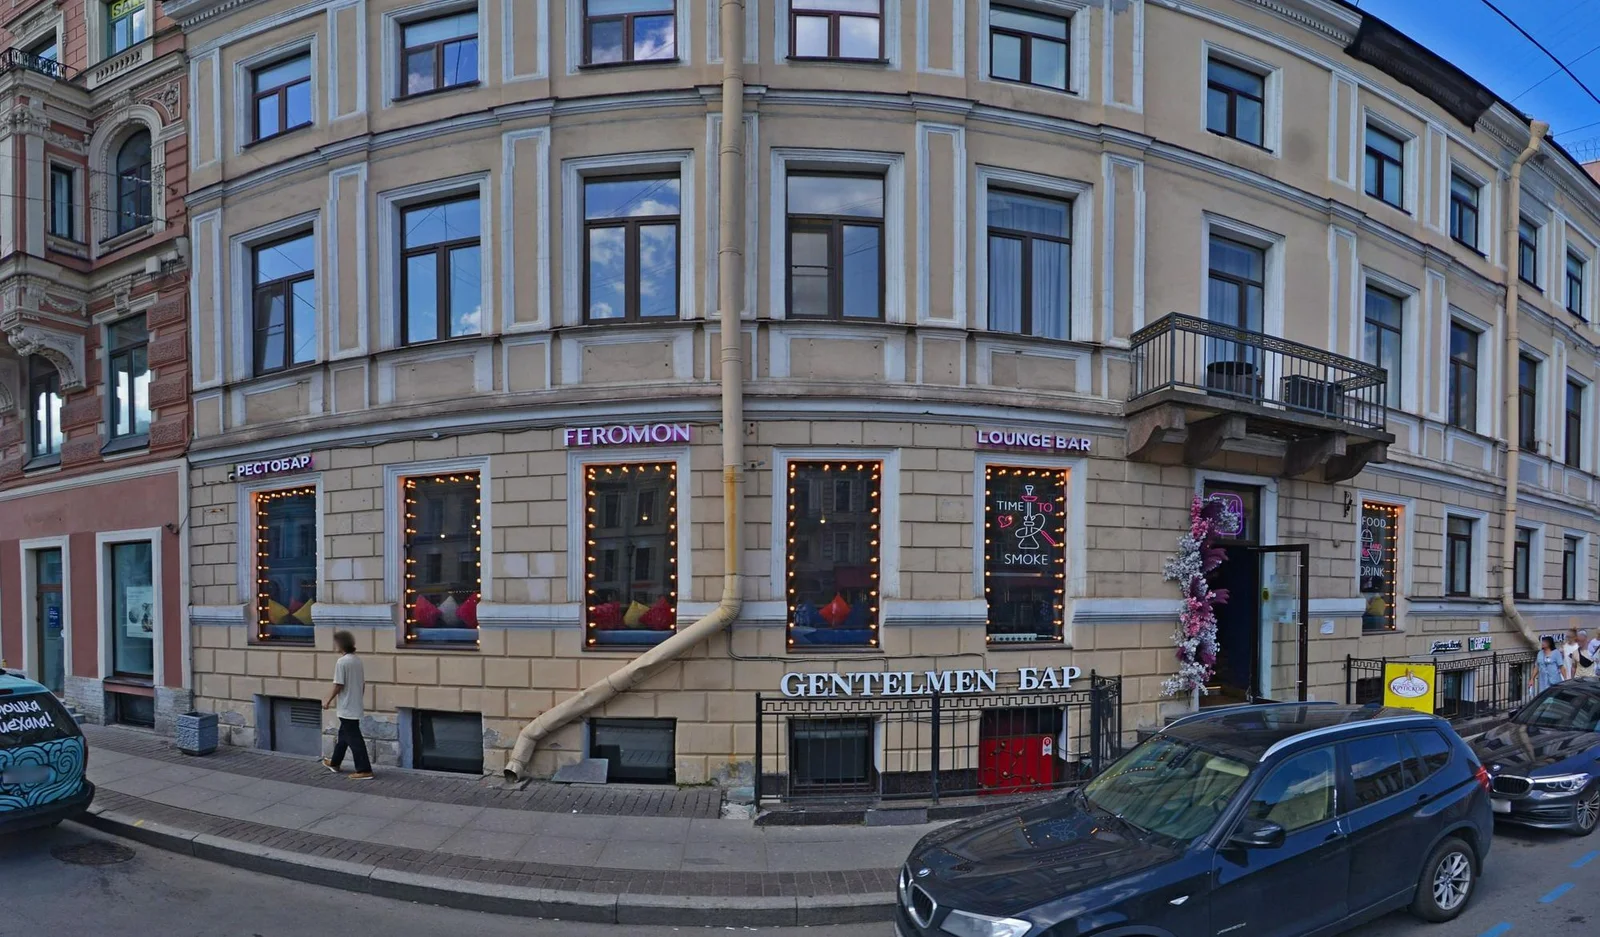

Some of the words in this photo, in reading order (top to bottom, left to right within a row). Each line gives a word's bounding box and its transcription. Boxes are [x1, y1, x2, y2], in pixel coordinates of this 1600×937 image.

[563, 423, 690, 447] FEROMON
[977, 429, 1052, 448] LOUNGE
[1055, 435, 1092, 452] BAR
[237, 455, 310, 477] РЕСТОБАР
[996, 500, 1025, 512] TIME
[1037, 502, 1053, 513] TO
[1361, 516, 1387, 528] FOOD
[1004, 553, 1049, 566] SMOKE
[1360, 566, 1385, 577] DRINK
[780, 669, 999, 698] GENTELMEN
[1017, 665, 1082, 691] БАР
[0, 711, 55, 733] иехала!
